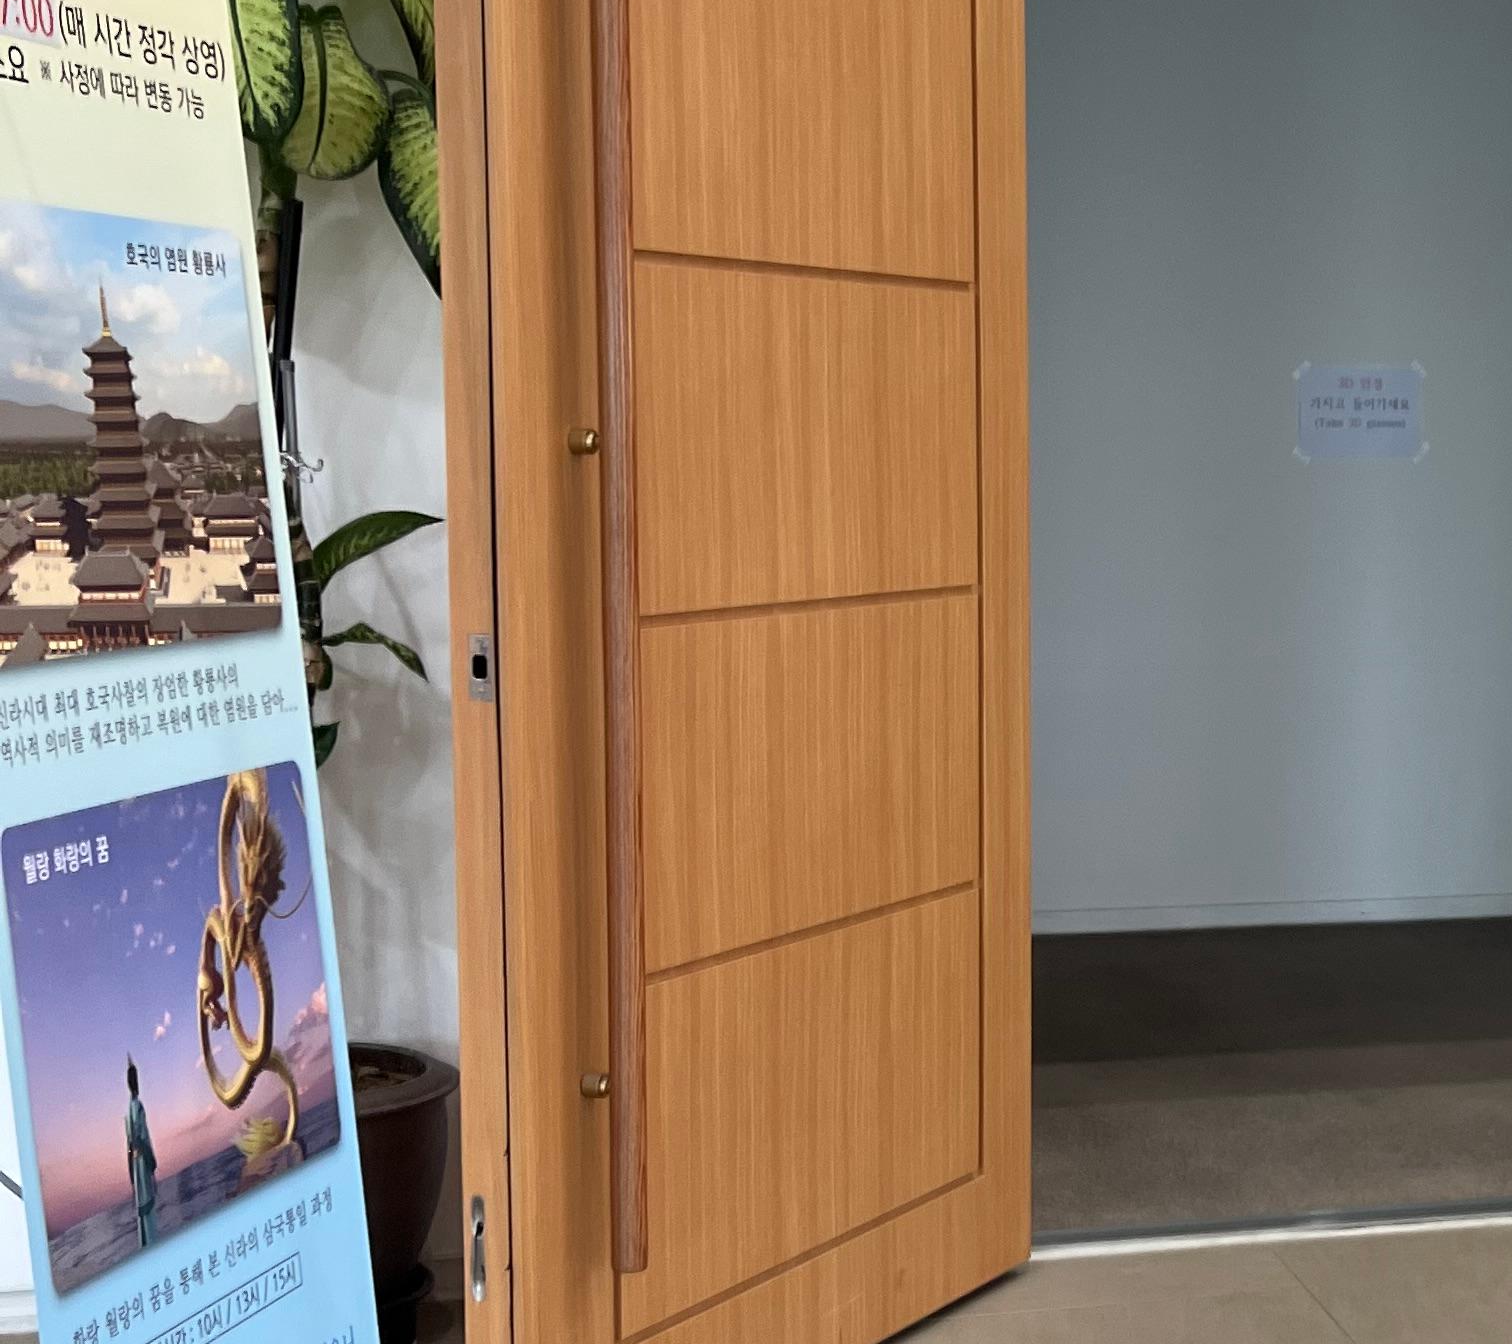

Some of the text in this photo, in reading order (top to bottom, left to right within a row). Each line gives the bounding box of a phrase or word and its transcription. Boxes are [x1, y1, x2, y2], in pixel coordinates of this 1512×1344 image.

[59, 1, 86, 48] (매
[95, 13, 131, 58] 시간
[138, 24, 176, 70] 정각
[182, 36, 226, 82] 상영)
[0, 45, 29, 83] 요
[60, 60, 106, 99] 사정에
[110, 72, 139, 107] 따라
[144, 79, 172, 113] 변동
[177, 87, 205, 119] 가능
[127, 242, 226, 277] 호국의 염원 황룡사
[1, 732, 40, 768] 역사적
[46, 726, 85, 759] 의미를
[89, 714, 153, 749] 재조명하고
[157, 705, 192, 735] 복원에
[197, 700, 221, 728] 대한
[224, 694, 258, 723] 염원을
[55, 688, 80, 720] 최대
[86, 677, 149, 712] 호국사찰의
[152, 672, 189, 703] 장엄한
[53, 839, 94, 874] 화랑의
[149, 1277, 175, 1313] 꿈을
[179, 1258, 204, 1295] 통해
[209, 1250, 221, 1278] 본
[225, 1226, 259, 1268] 신라의
[263, 1200, 307, 1248] 삼국통일
[311, 1186, 333, 1216] 과정
